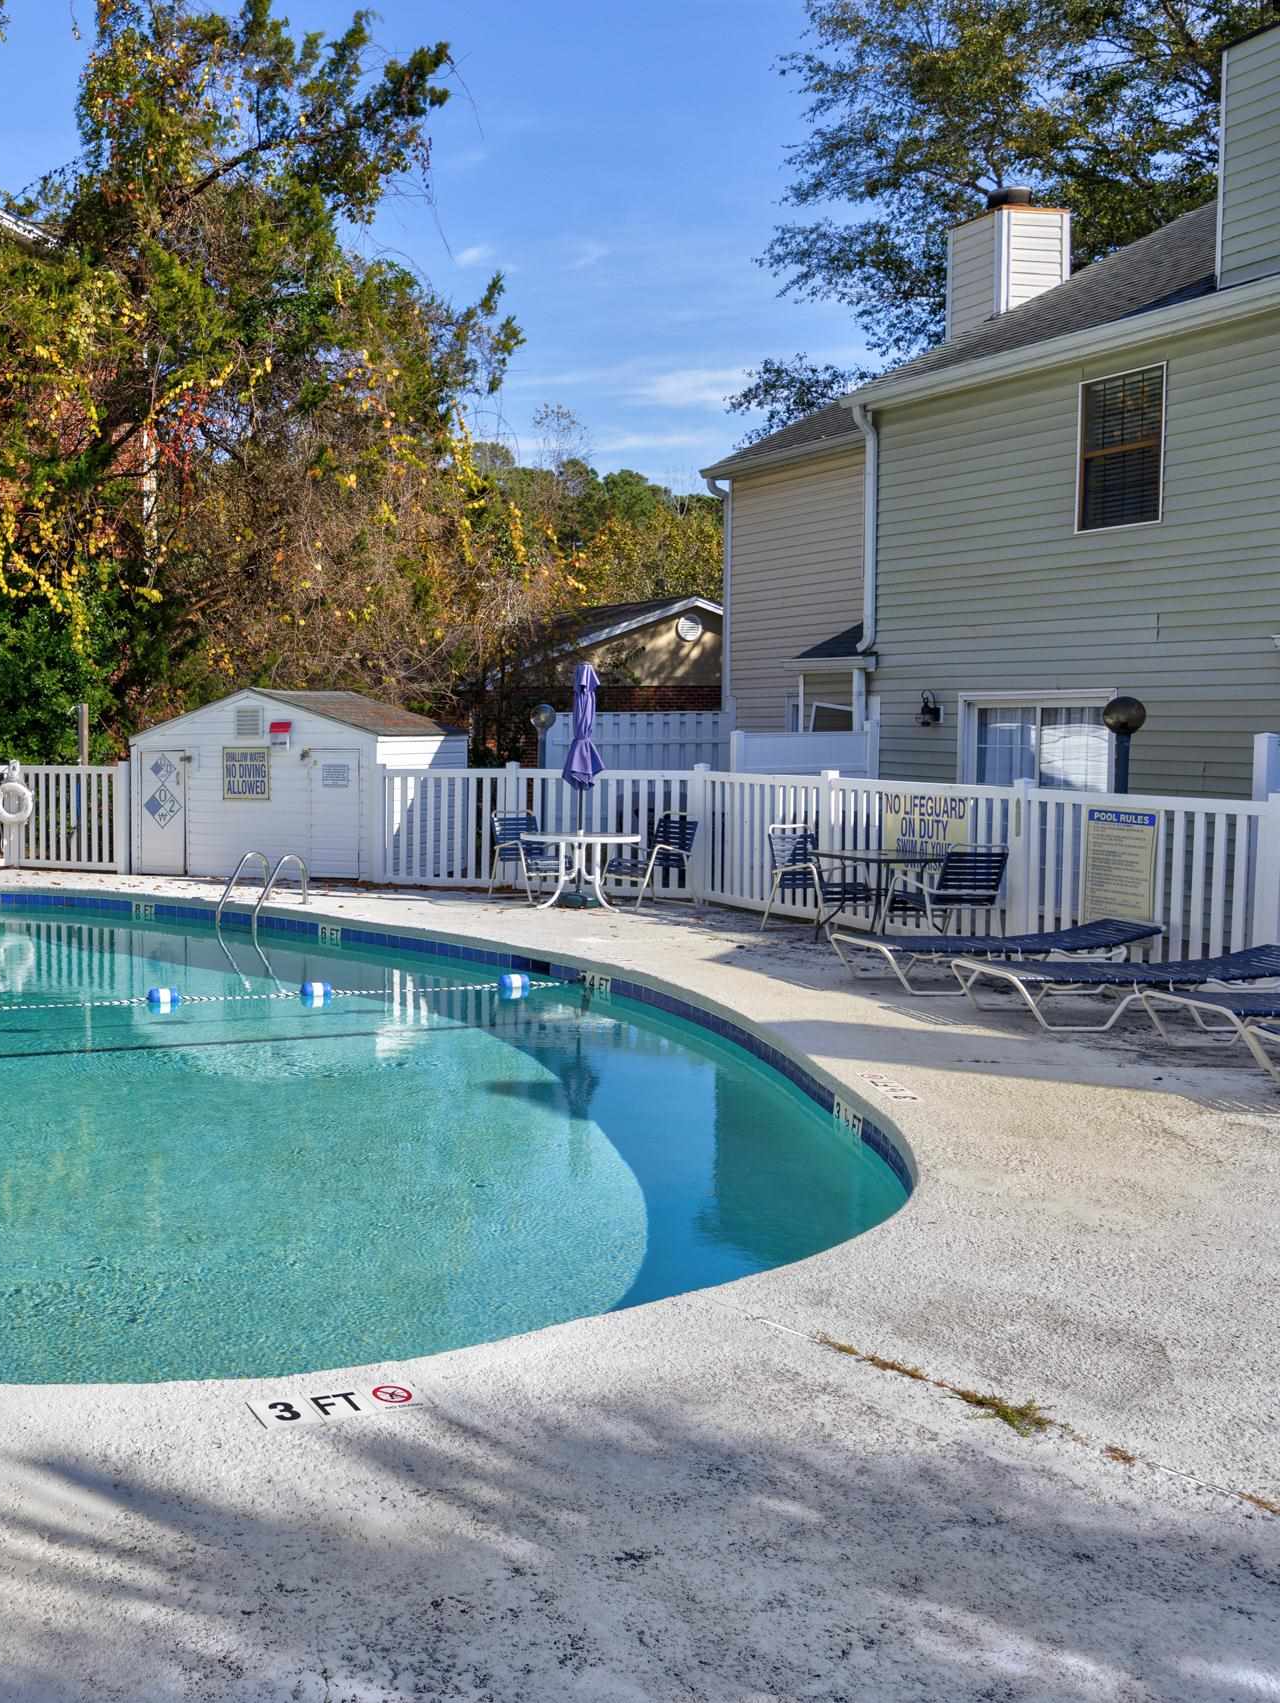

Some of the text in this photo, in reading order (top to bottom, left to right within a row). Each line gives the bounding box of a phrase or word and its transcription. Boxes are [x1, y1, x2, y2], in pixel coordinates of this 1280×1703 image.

[226, 751, 266, 762] SHALLOW WATER
[226, 763, 266, 778] NO DIVING
[227, 780, 266, 795] ALLOWED
[885, 794, 966, 819] NO LIFEGUARD
[1094, 811, 1150, 825] POOL RULES
[901, 817, 949, 841] ON DUTY
[896, 838, 917, 853] SWIM
[920, 840, 928, 855] AT
[268, 1401, 302, 1422] 3
[310, 1391, 362, 1416] FT
